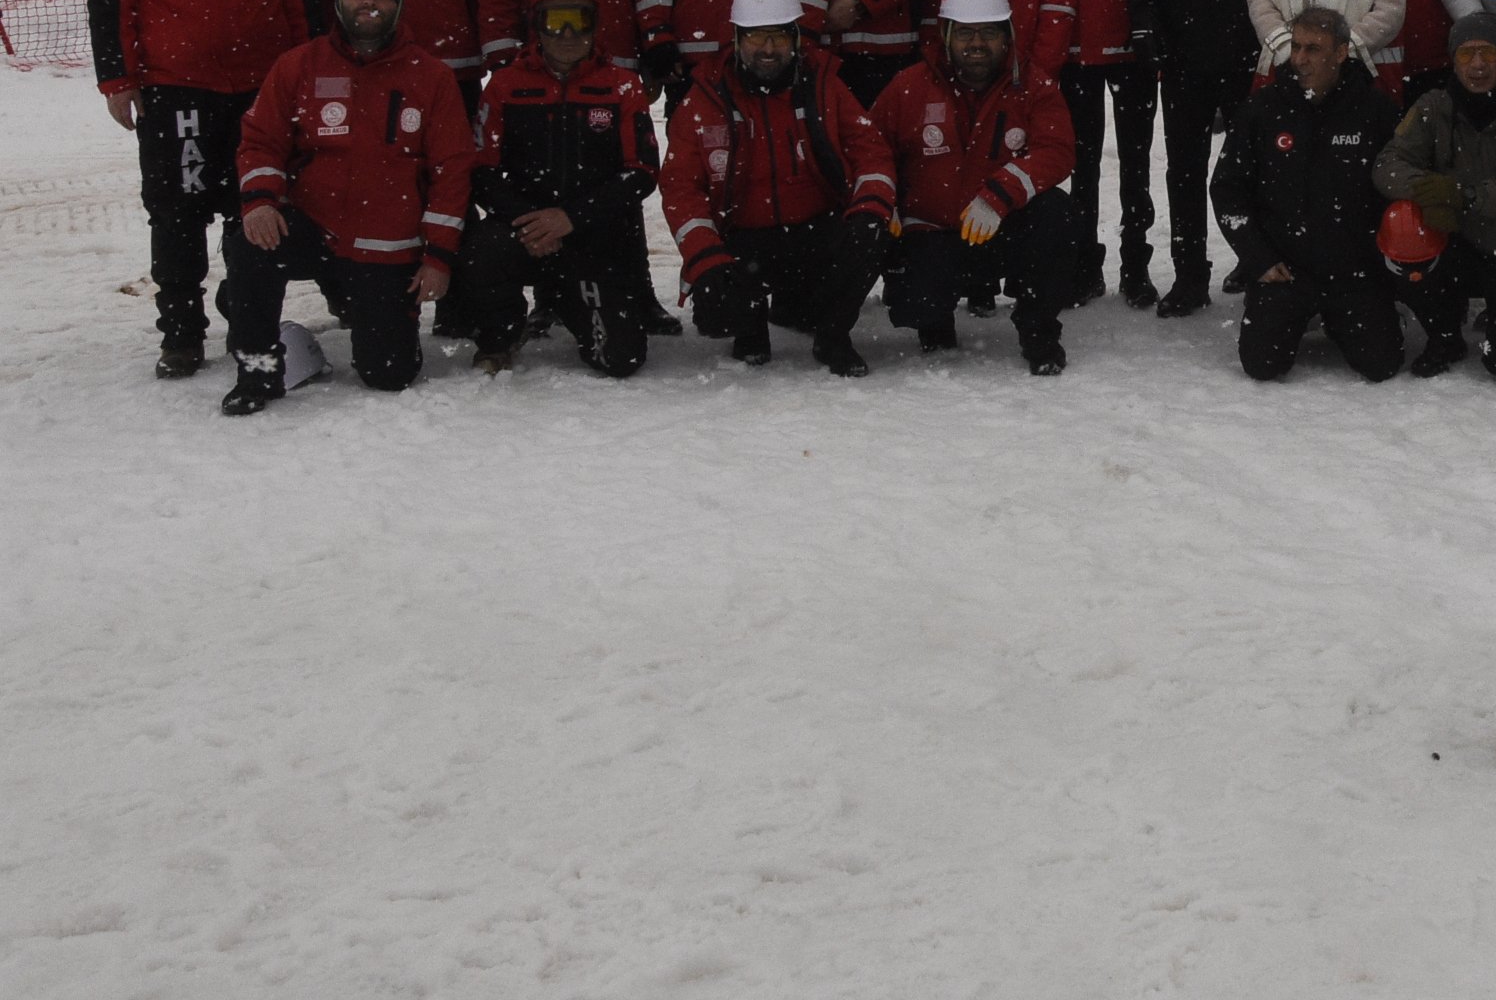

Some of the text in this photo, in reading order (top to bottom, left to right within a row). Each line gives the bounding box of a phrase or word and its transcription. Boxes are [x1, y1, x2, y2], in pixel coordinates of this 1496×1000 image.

[590, 111, 609, 120] HAK
[1331, 135, 1361, 146] AFAD
[176, 109, 207, 194] HAK
